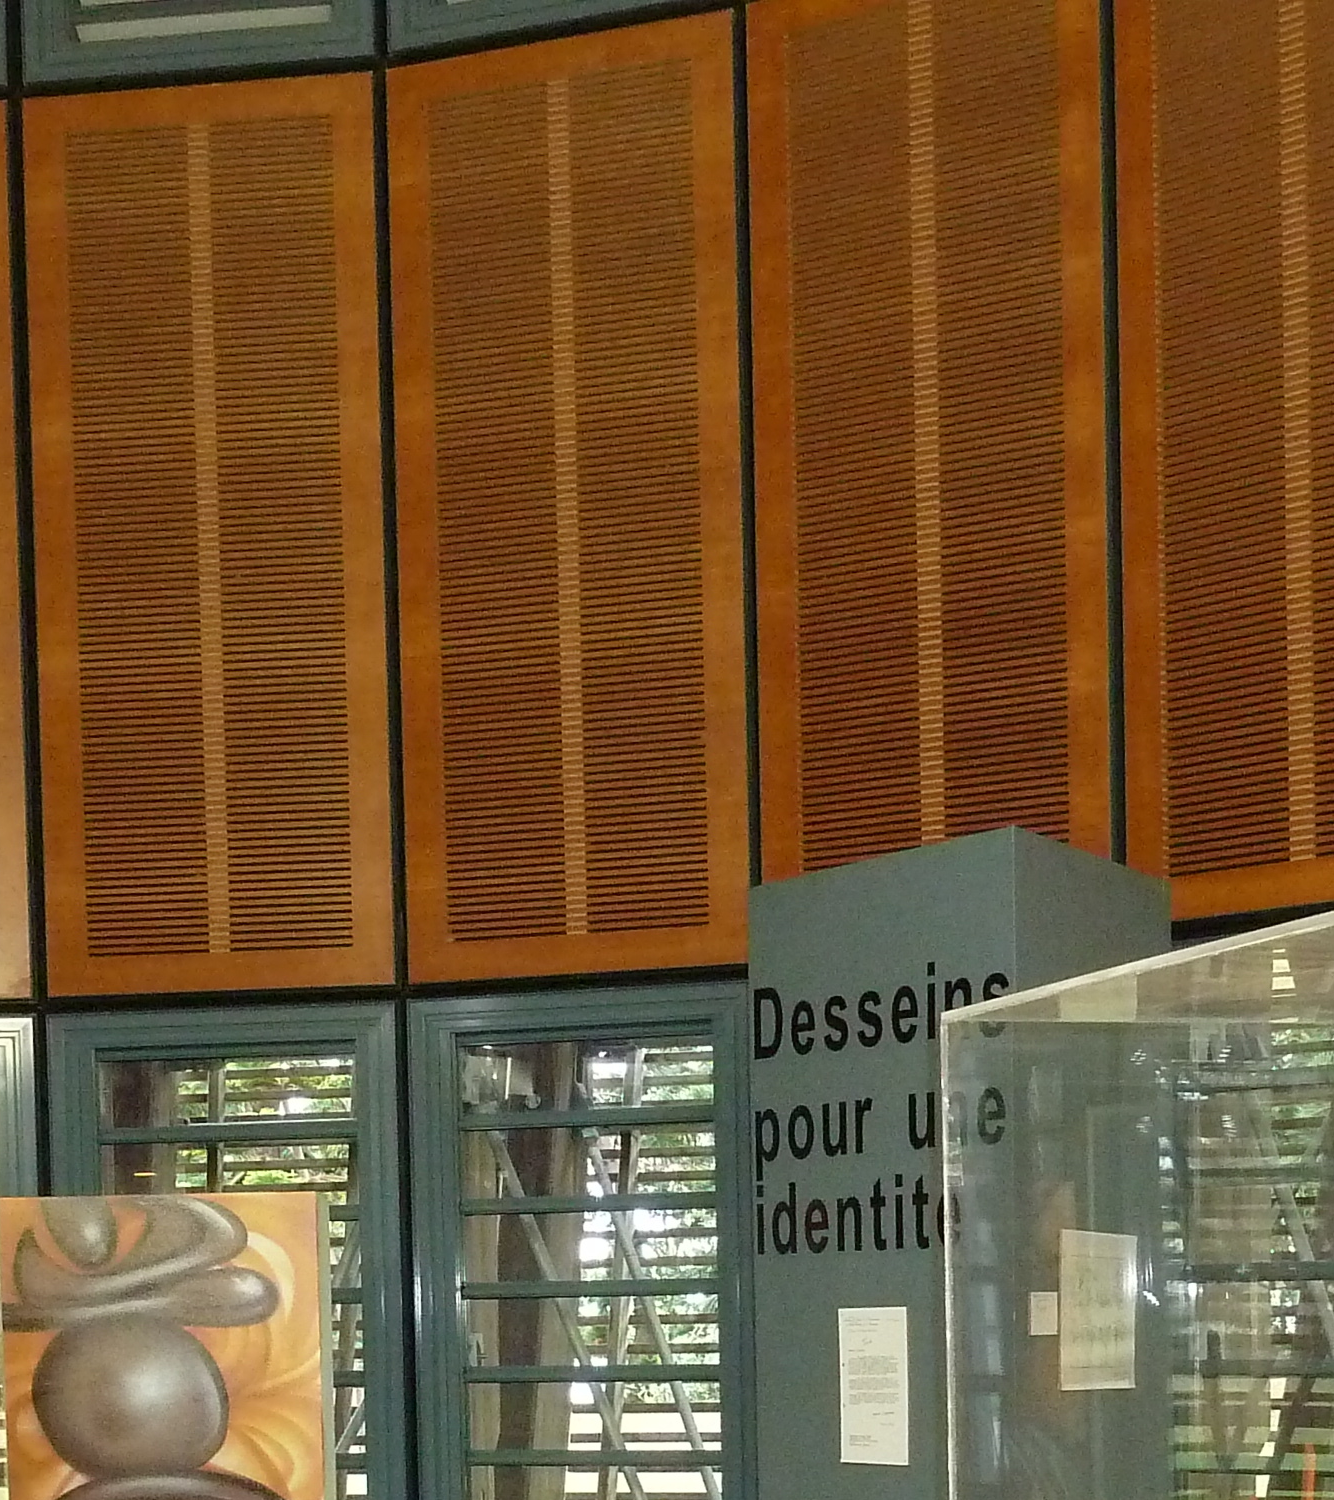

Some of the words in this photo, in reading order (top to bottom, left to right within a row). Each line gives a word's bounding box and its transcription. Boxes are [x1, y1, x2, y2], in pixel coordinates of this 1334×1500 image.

[754, 962, 1010, 1060] Desseins
[755, 1097, 873, 1181] pour
[908, 1087, 1006, 1150] une
